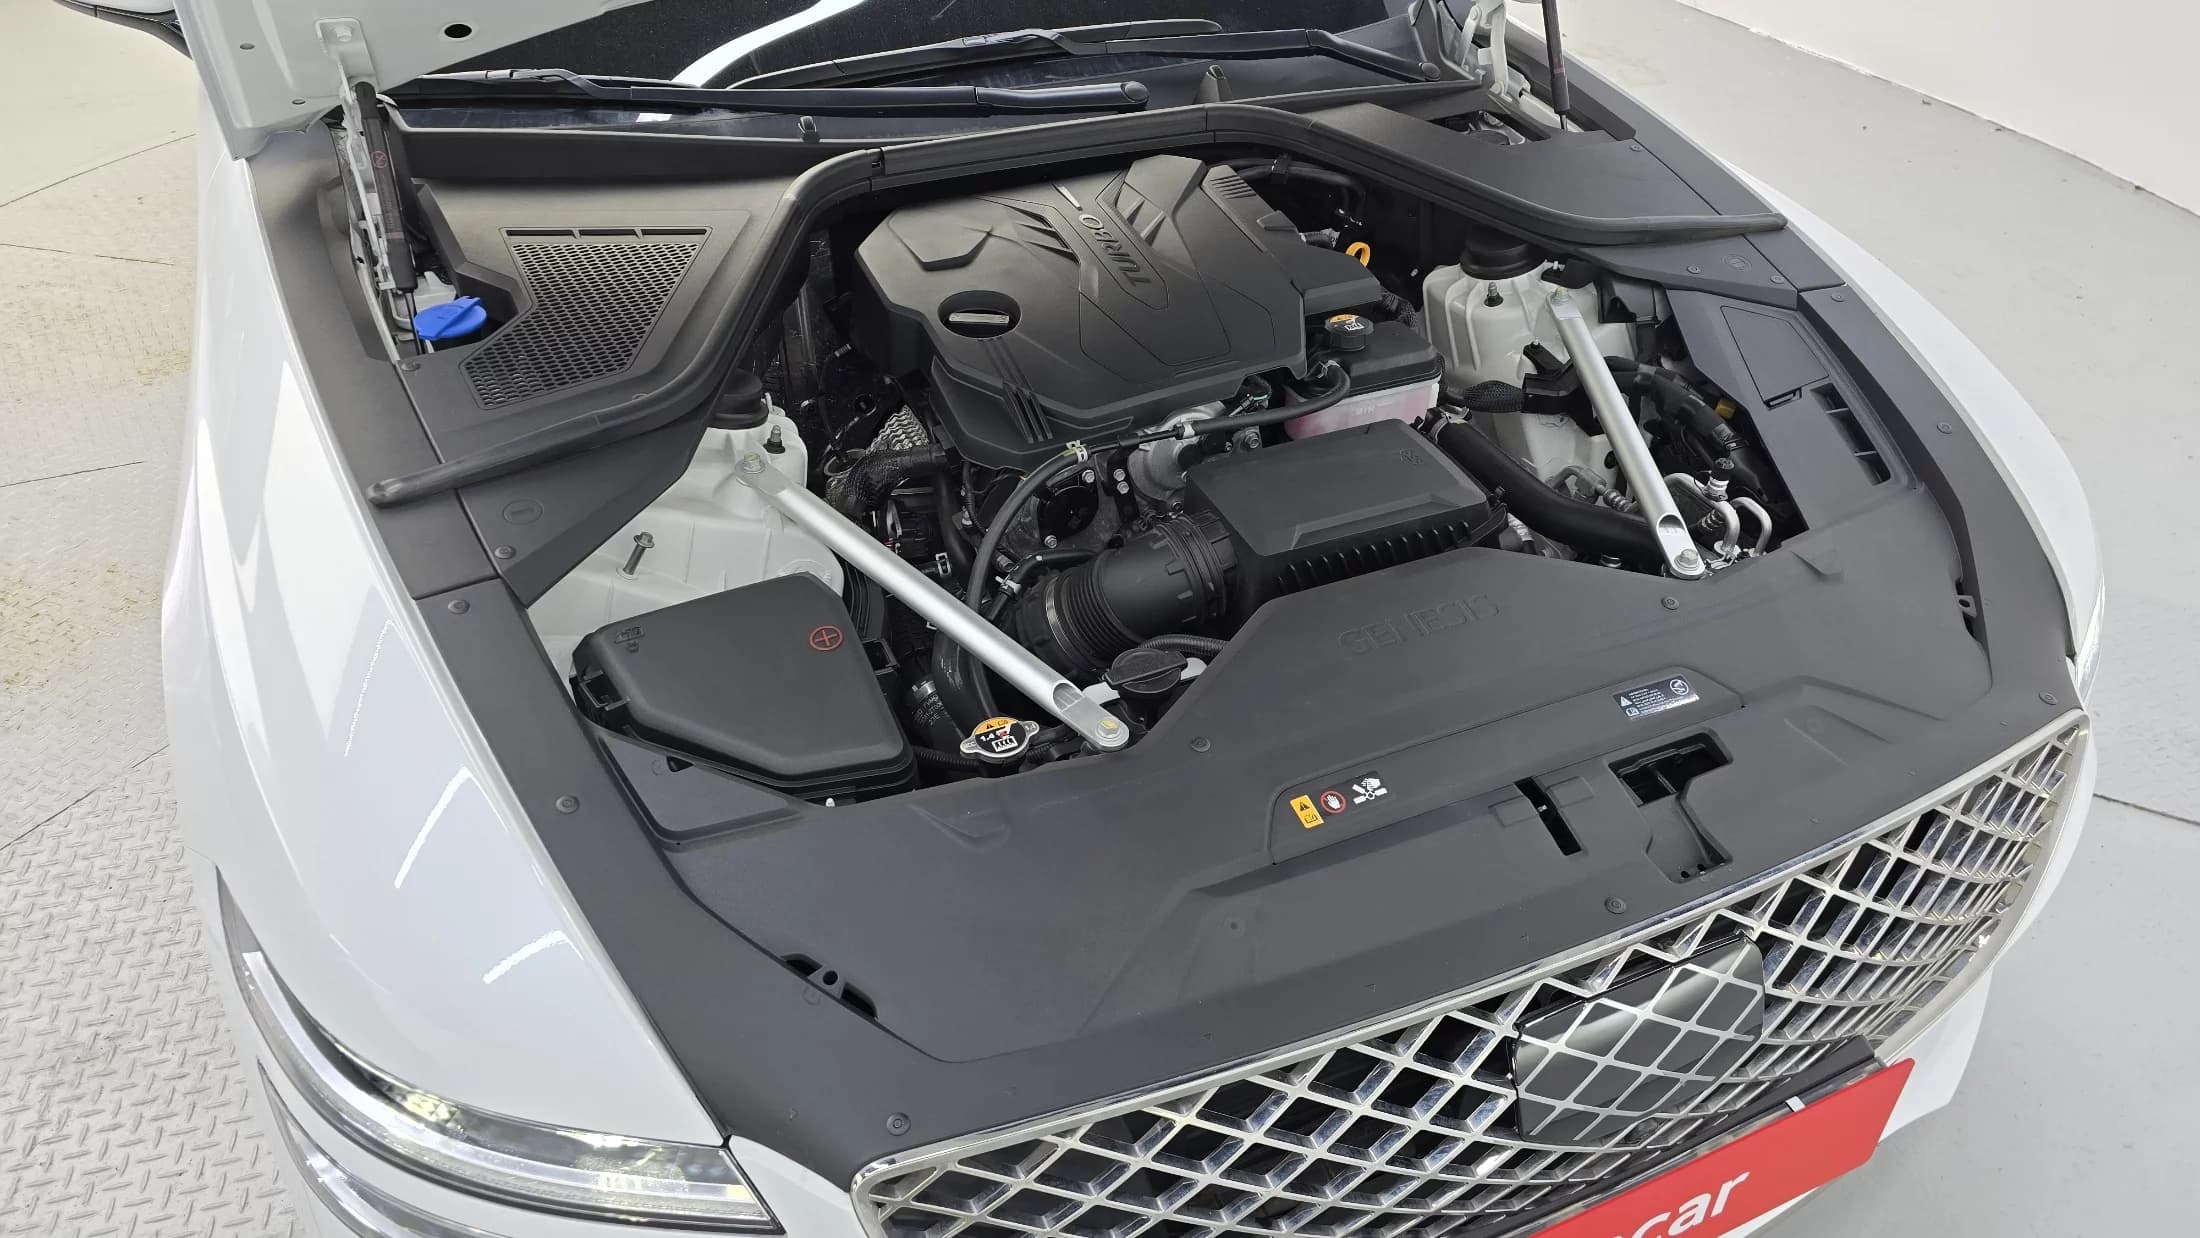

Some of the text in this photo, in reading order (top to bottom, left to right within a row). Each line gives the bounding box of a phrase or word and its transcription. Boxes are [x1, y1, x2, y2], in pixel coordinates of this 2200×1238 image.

[1079, 214, 1152, 287] TURBO
[980, 732, 996, 742] 1.4
[1611, 1171, 1751, 1238] car
